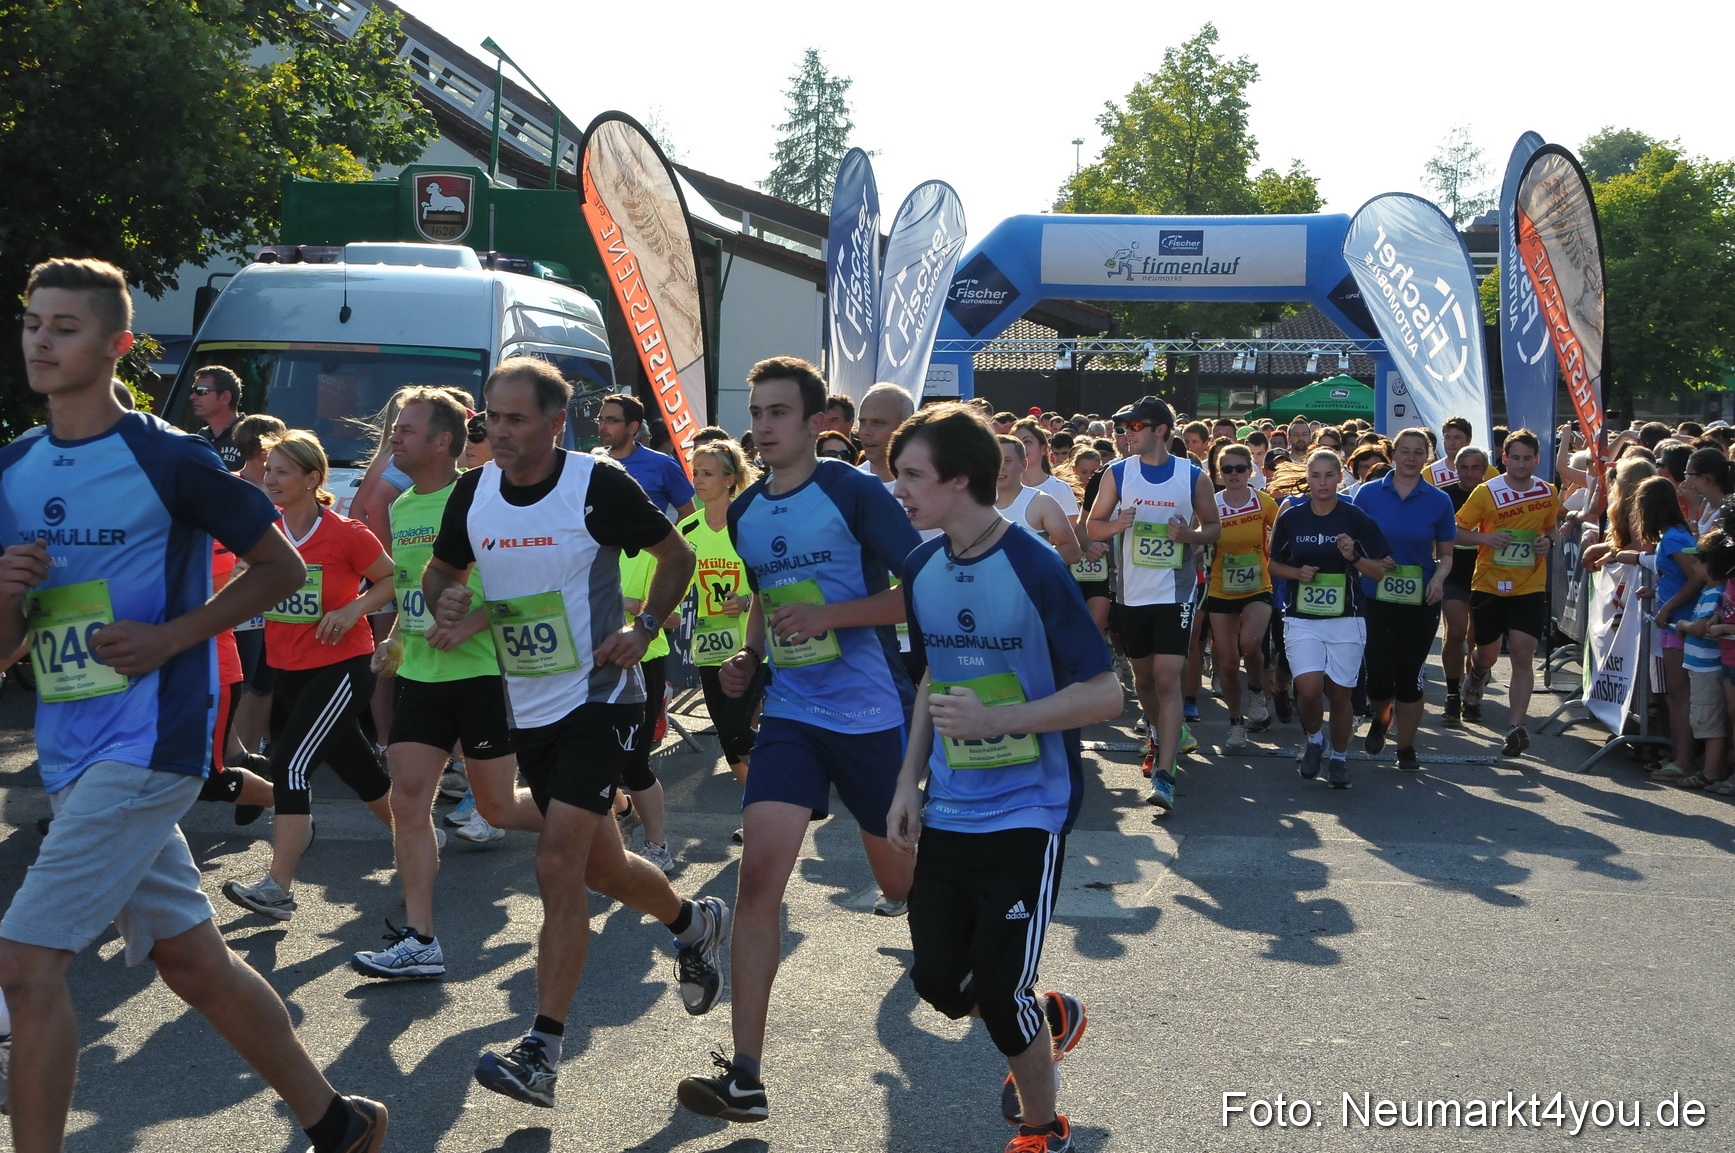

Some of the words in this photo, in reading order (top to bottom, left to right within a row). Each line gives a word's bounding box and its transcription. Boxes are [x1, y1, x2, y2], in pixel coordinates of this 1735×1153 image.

[431, 226, 456, 236] 1628
[1168, 239, 1201, 247] Fischer
[846, 184, 869, 336] Fischer
[1143, 256, 1241, 275] firmenlauf
[897, 210, 948, 344] Fischer
[914, 235, 953, 342] AUTOMOBILE
[956, 288, 1008, 299] Fischer
[1144, 500, 1177, 508] KLEBL
[1498, 507, 1525, 520] MAX
[1527, 501, 1553, 513] BÖGL
[1241, 514, 1264, 524] BÖGL
[393, 525, 435, 540] utoladen
[397, 533, 437, 547] neumar
[1296, 535, 1317, 543] EURO
[1325, 535, 1338, 543] PO
[499, 536, 559, 549] KLEBL
[1139, 537, 1175, 558] 523
[1500, 543, 1530, 559] 773
[698, 558, 741, 570] Müller
[1075, 559, 1103, 573] 335
[1226, 567, 1256, 584] 754
[1383, 576, 1416, 595] 689
[1303, 586, 1338, 605] 326
[502, 622, 558, 658] 549
[696, 631, 734, 654] 280
[922, 632, 1024, 652] SCHABMÜLLER
[957, 656, 985, 666] TEAM
[1005, 912, 1030, 920] adidas
